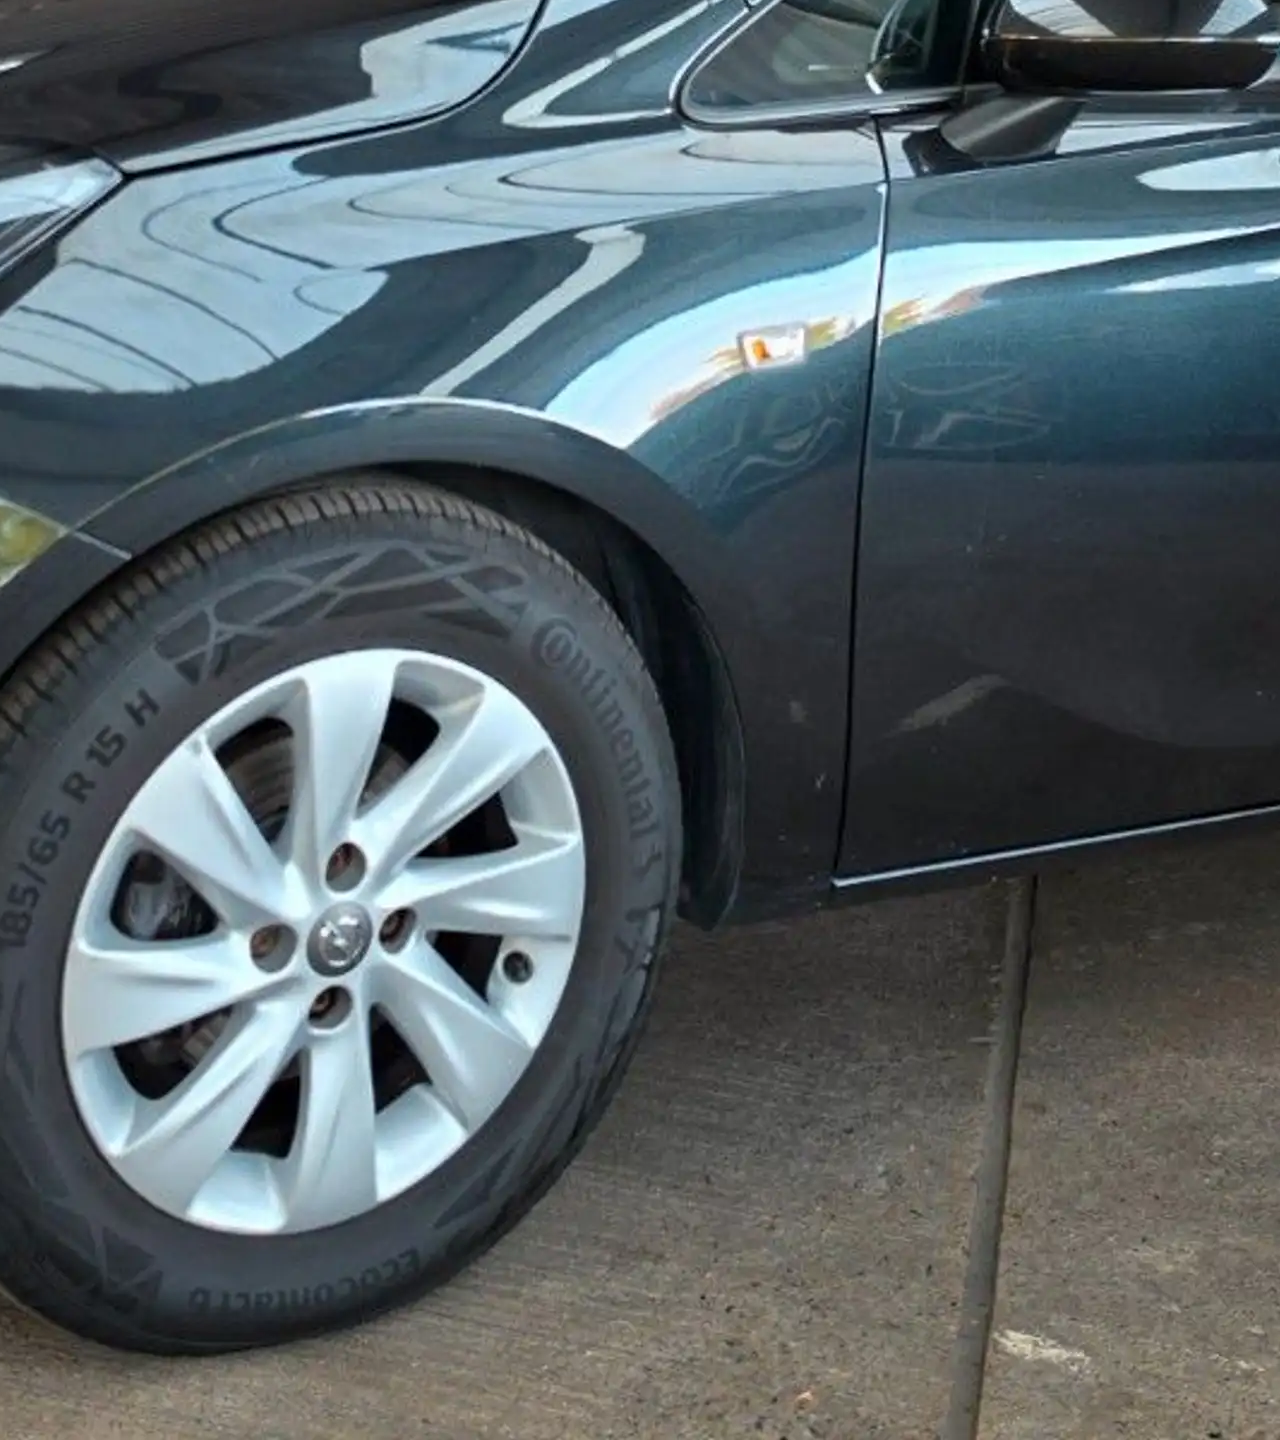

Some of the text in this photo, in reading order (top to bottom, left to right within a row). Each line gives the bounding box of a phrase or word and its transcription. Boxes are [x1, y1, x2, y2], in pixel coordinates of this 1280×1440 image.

[61, 771, 96, 804] R
[86, 724, 127, 767] 15
[124, 688, 160, 727] H
[532, 618, 659, 839] Continental
